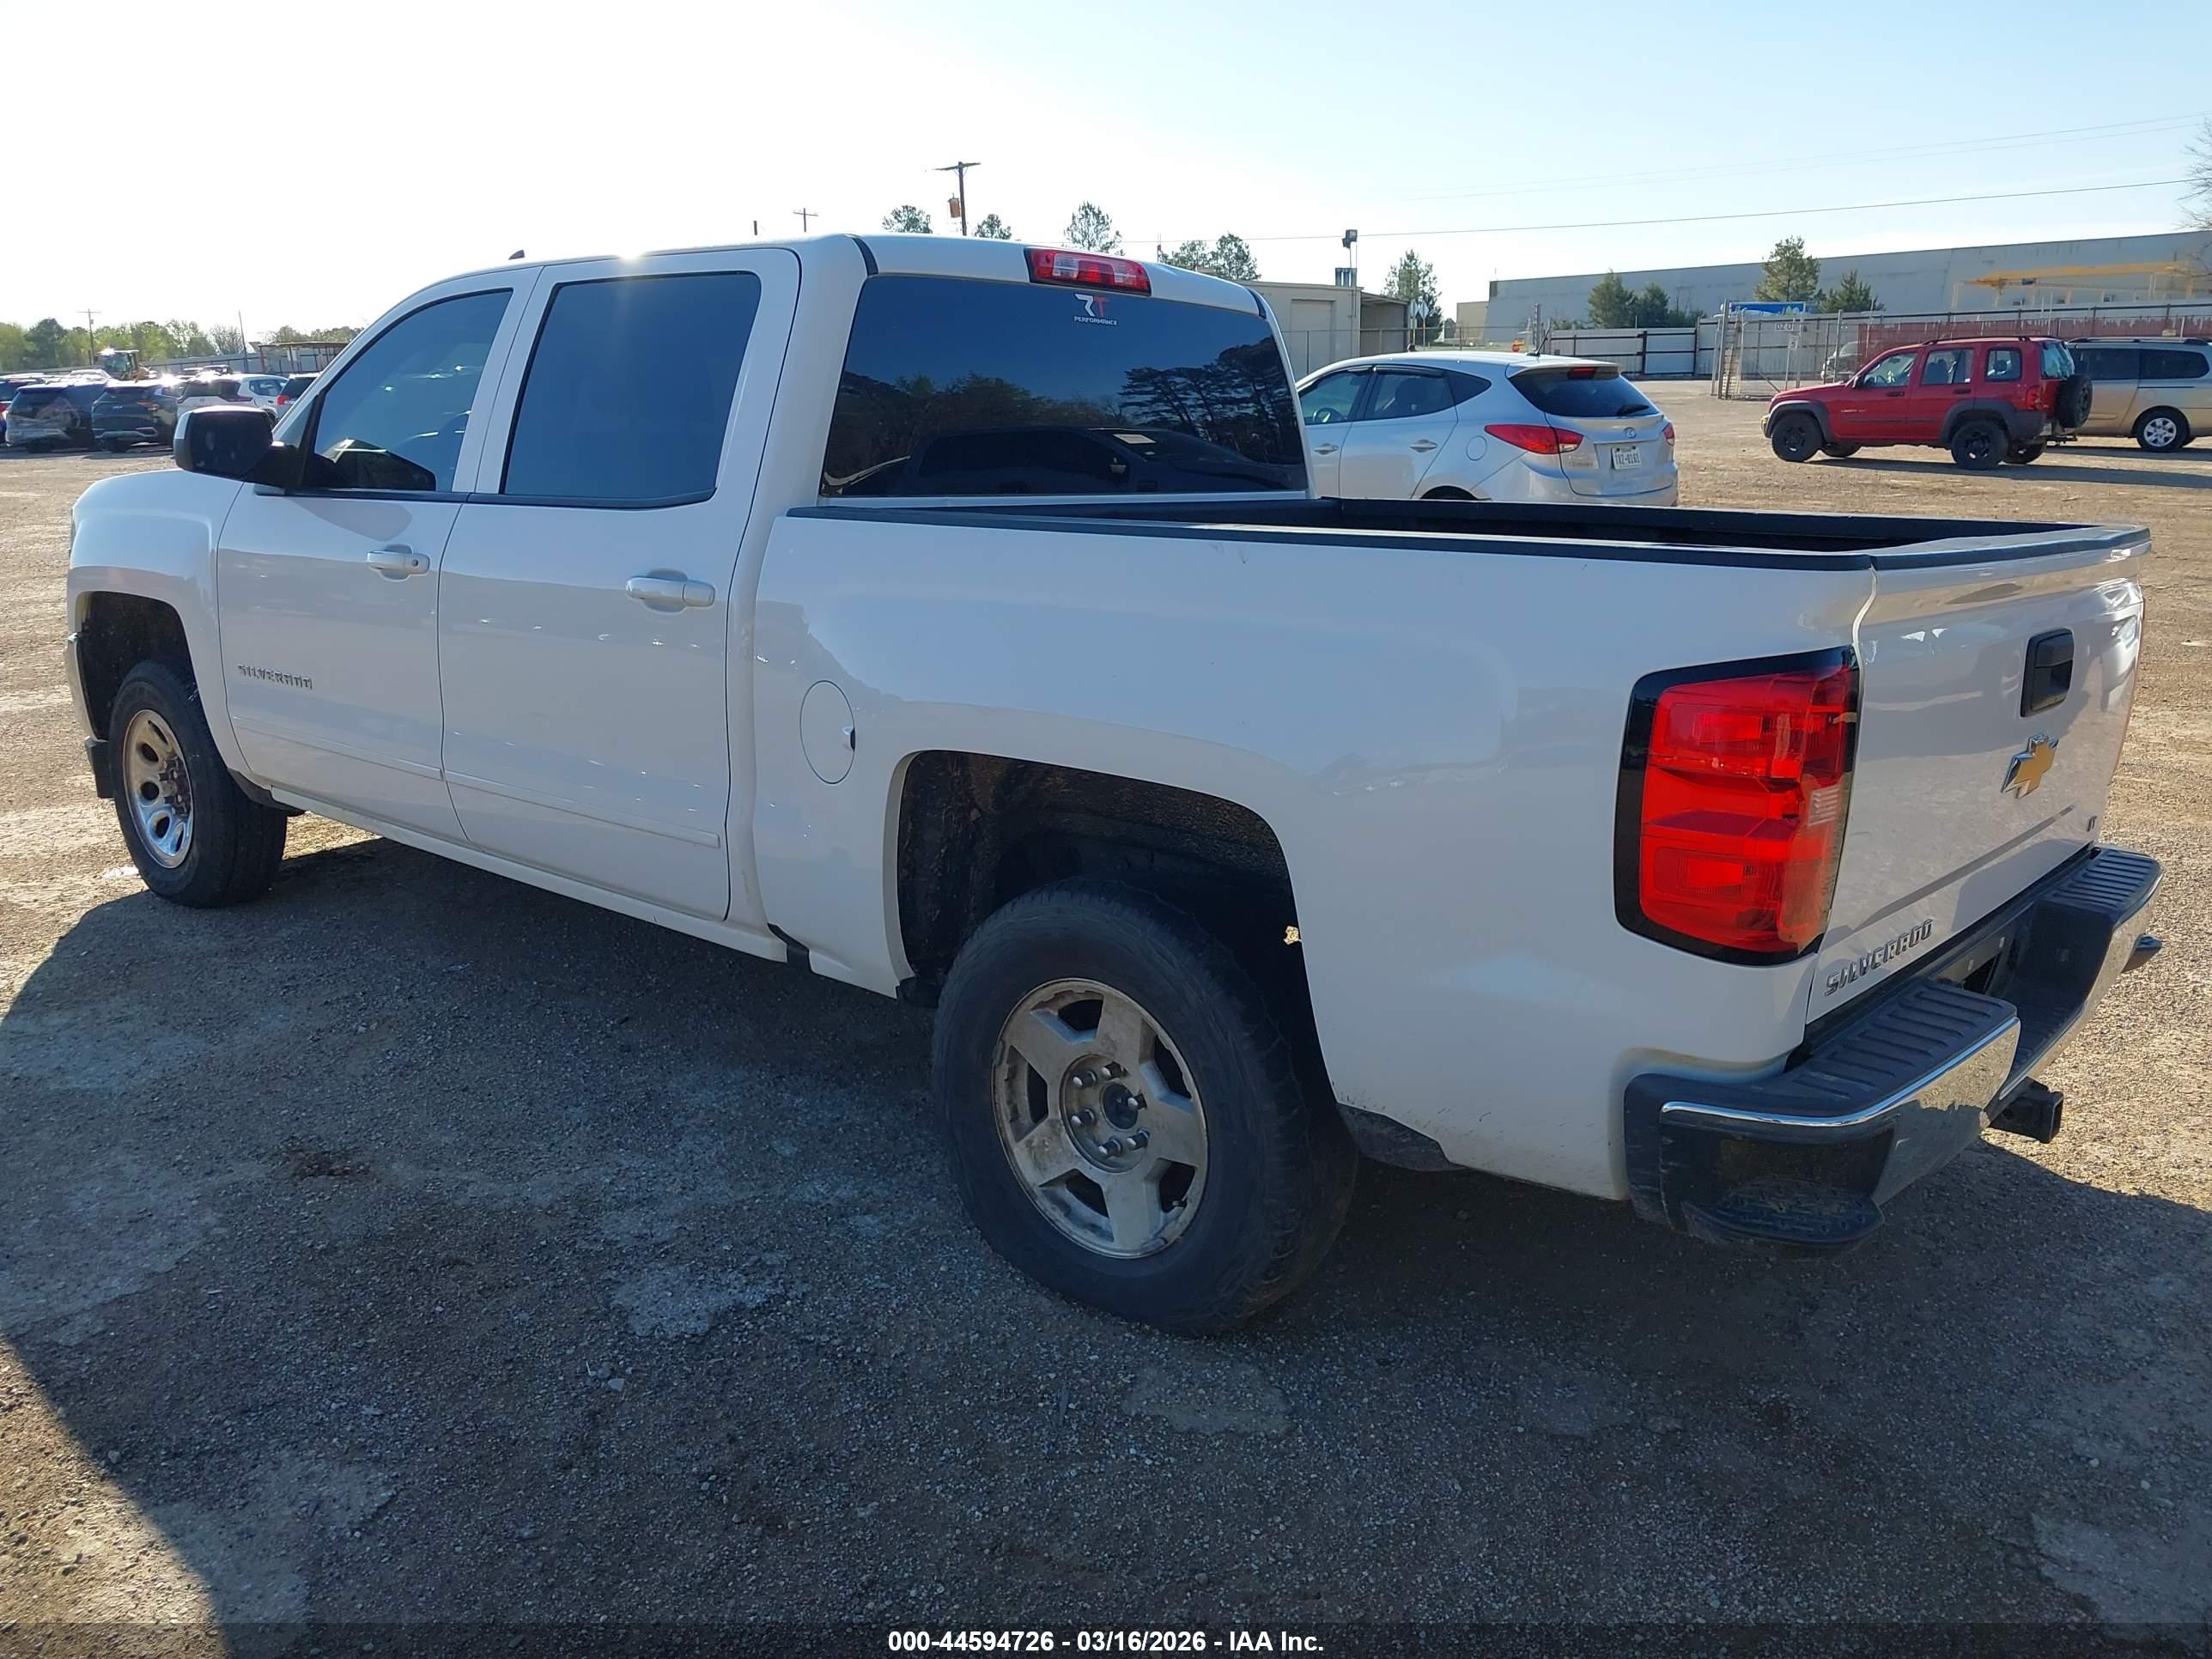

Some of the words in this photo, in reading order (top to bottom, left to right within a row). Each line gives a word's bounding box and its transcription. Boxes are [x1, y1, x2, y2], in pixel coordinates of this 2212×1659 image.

[1073, 315, 1118, 326] PERFORMANCE
[237, 664, 313, 690] SILVERADO
[1824, 916, 1936, 997] SILVERADO
